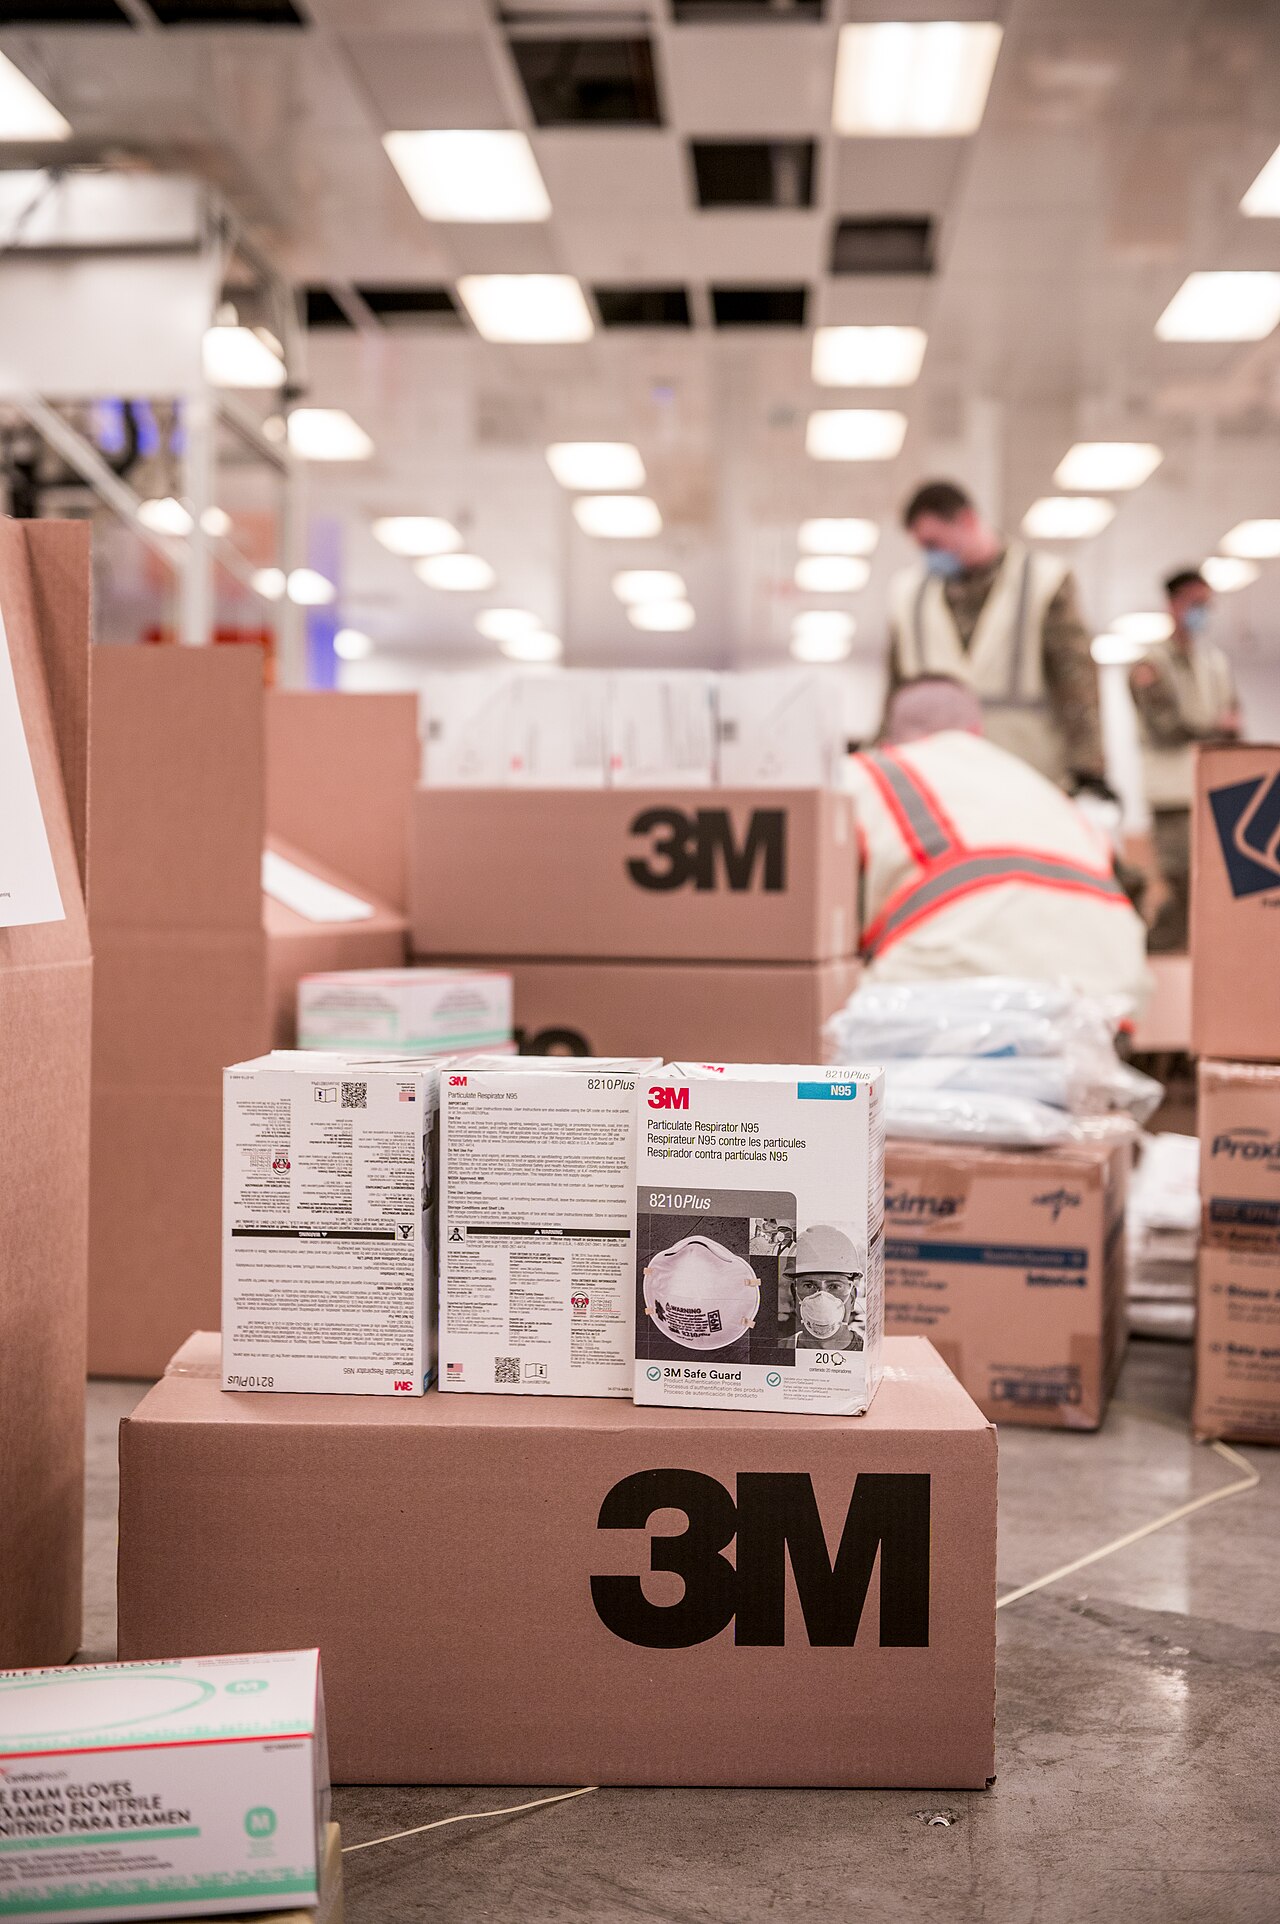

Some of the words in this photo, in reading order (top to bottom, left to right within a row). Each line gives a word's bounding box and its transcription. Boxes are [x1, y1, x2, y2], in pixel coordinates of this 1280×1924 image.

[627, 806, 787, 892] 3M
[448, 1076, 468, 1087] 3M
[825, 1070, 870, 1080] 8210Plus
[587, 1078, 635, 1091] 8210Plus
[830, 1084, 852, 1097] N95
[448, 1091, 476, 1099] Particulate
[477, 1092, 505, 1100] Respirator
[647, 1086, 690, 1110] 3M
[647, 1120, 692, 1131] Particulate
[695, 1121, 738, 1134] Respirator
[741, 1122, 760, 1133] N95
[647, 1133, 695, 1146] Respirateur
[698, 1135, 716, 1146] N95
[719, 1136, 746, 1146] contre
[749, 1137, 761, 1147] les
[764, 1138, 806, 1149] particules
[647, 1147, 692, 1159] Respirador
[695, 1149, 722, 1159] contra
[725, 1150, 767, 1162] partículas
[769, 1151, 788, 1162] N95
[649, 1194, 711, 1210] 8210Plus
[815, 1352, 829, 1364] 20
[356, 1367, 384, 1375] Respirator
[664, 1368, 681, 1378] 3M
[684, 1368, 707, 1379] Safe
[709, 1370, 742, 1380] Guard
[227, 1375, 274, 1387] 8210Plus
[394, 1381, 413, 1391] 3M
[590, 1468, 931, 1649] 3M
[104, 1658, 182, 1671] GLOVES
[234, 1681, 259, 1692] M
[12, 1787, 61, 1803] EXAM
[65, 1780, 132, 1799] GLOVES
[71, 1801, 93, 1813] EN
[98, 1795, 161, 1812] NITRILE
[69, 1816, 113, 1831] PARA
[118, 1809, 191, 1828] EXAMEN
[251, 1813, 271, 1831] M
